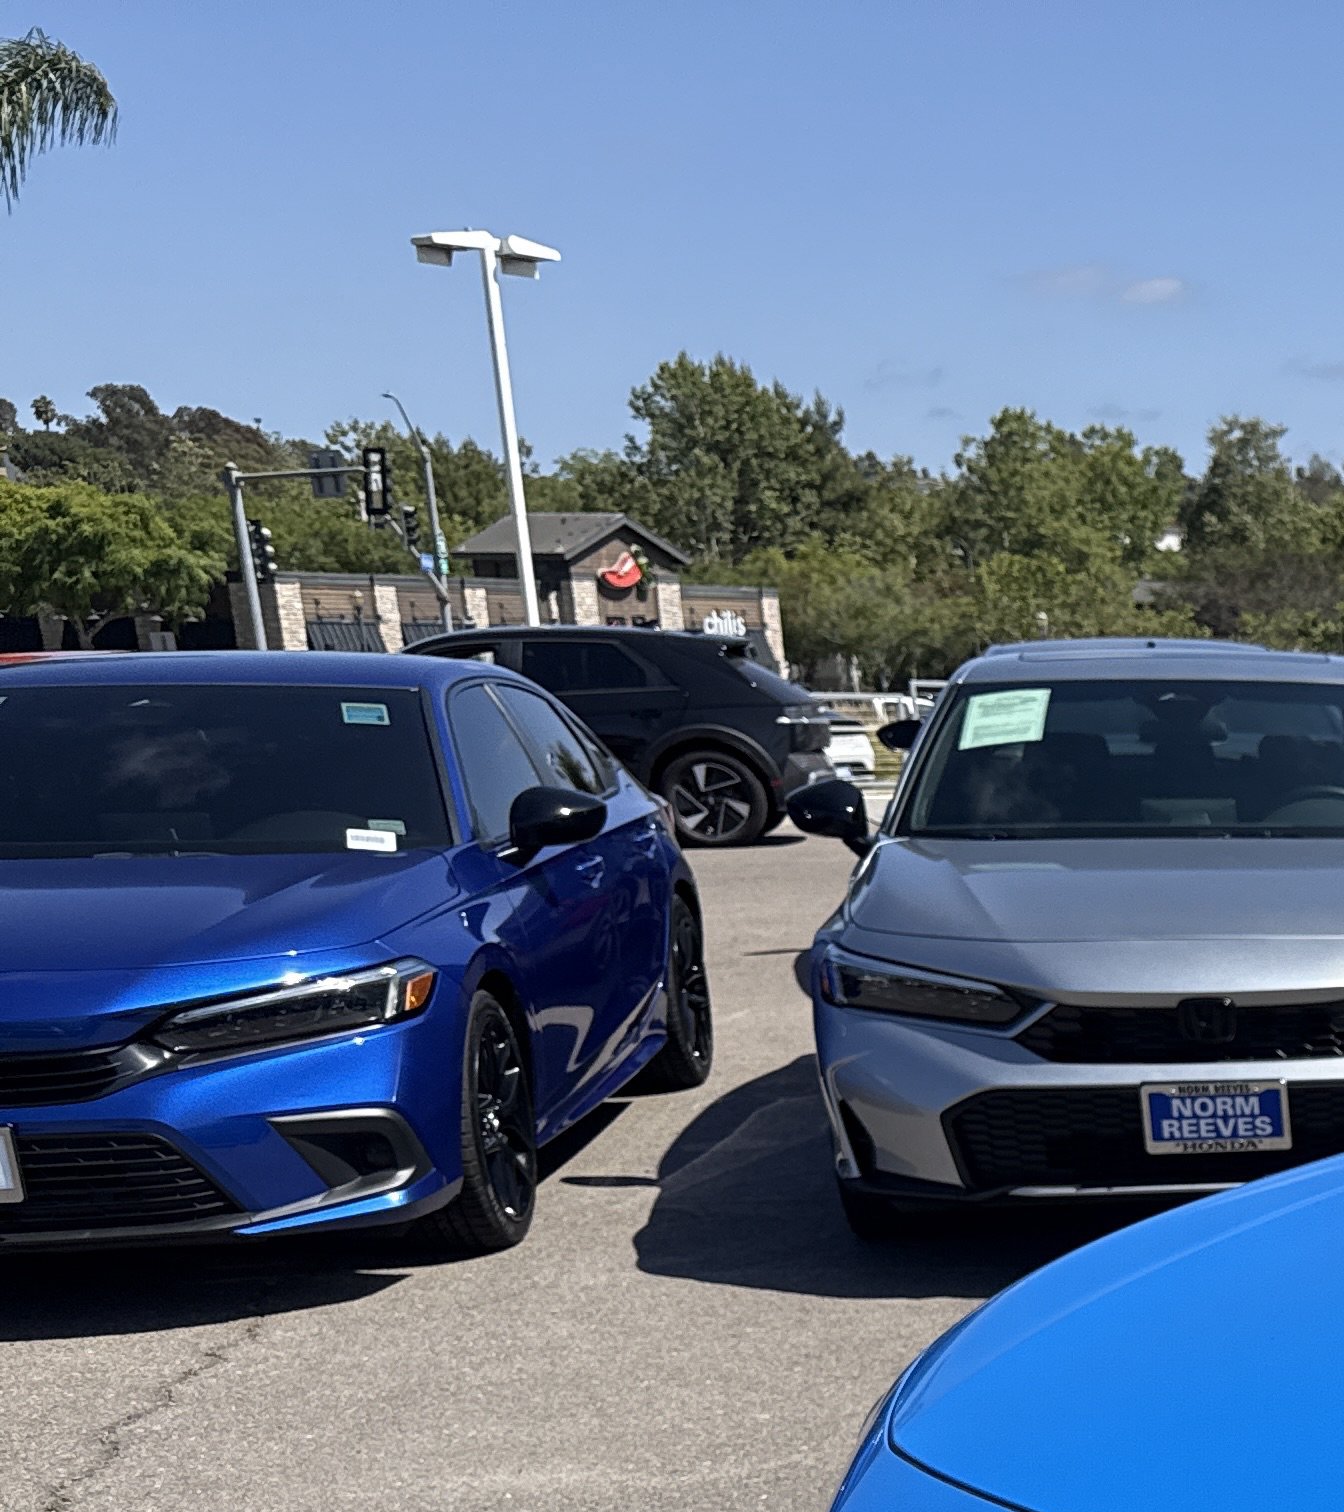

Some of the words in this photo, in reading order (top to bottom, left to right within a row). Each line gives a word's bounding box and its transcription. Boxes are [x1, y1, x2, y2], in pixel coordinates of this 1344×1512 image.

[1178, 1085, 1210, 1094] NORM
[1214, 1084, 1251, 1094] REEVES
[1171, 1096, 1261, 1118] NORM
[1161, 1116, 1274, 1139] REEVES
[1182, 1139, 1259, 1152] HONDA
